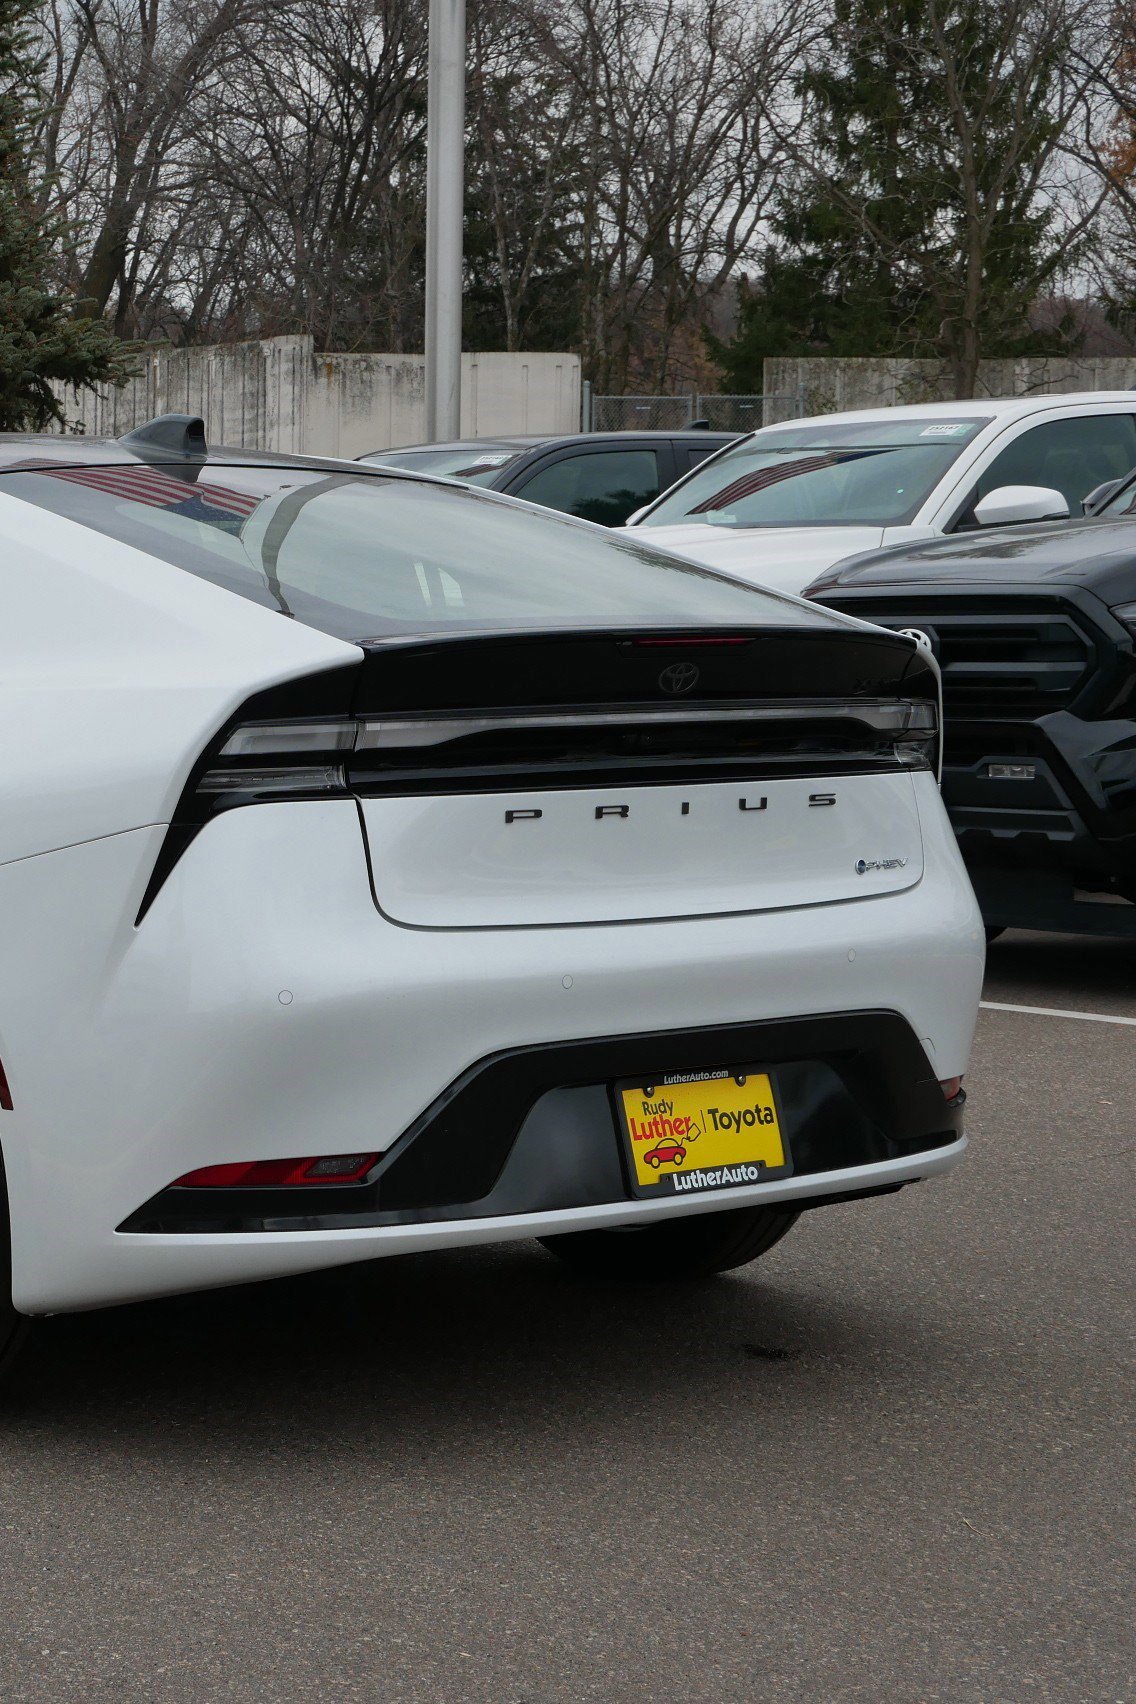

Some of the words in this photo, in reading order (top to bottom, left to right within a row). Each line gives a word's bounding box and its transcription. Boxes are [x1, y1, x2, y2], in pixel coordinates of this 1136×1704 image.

[504, 792, 837, 824] PRIUS
[664, 1069, 729, 1085] LutherAuto.com
[642, 1098, 674, 1117] Rudy
[707, 1104, 775, 1133] Toyota
[630, 1113, 693, 1141] Luther
[672, 1163, 759, 1191] LutherAuto
